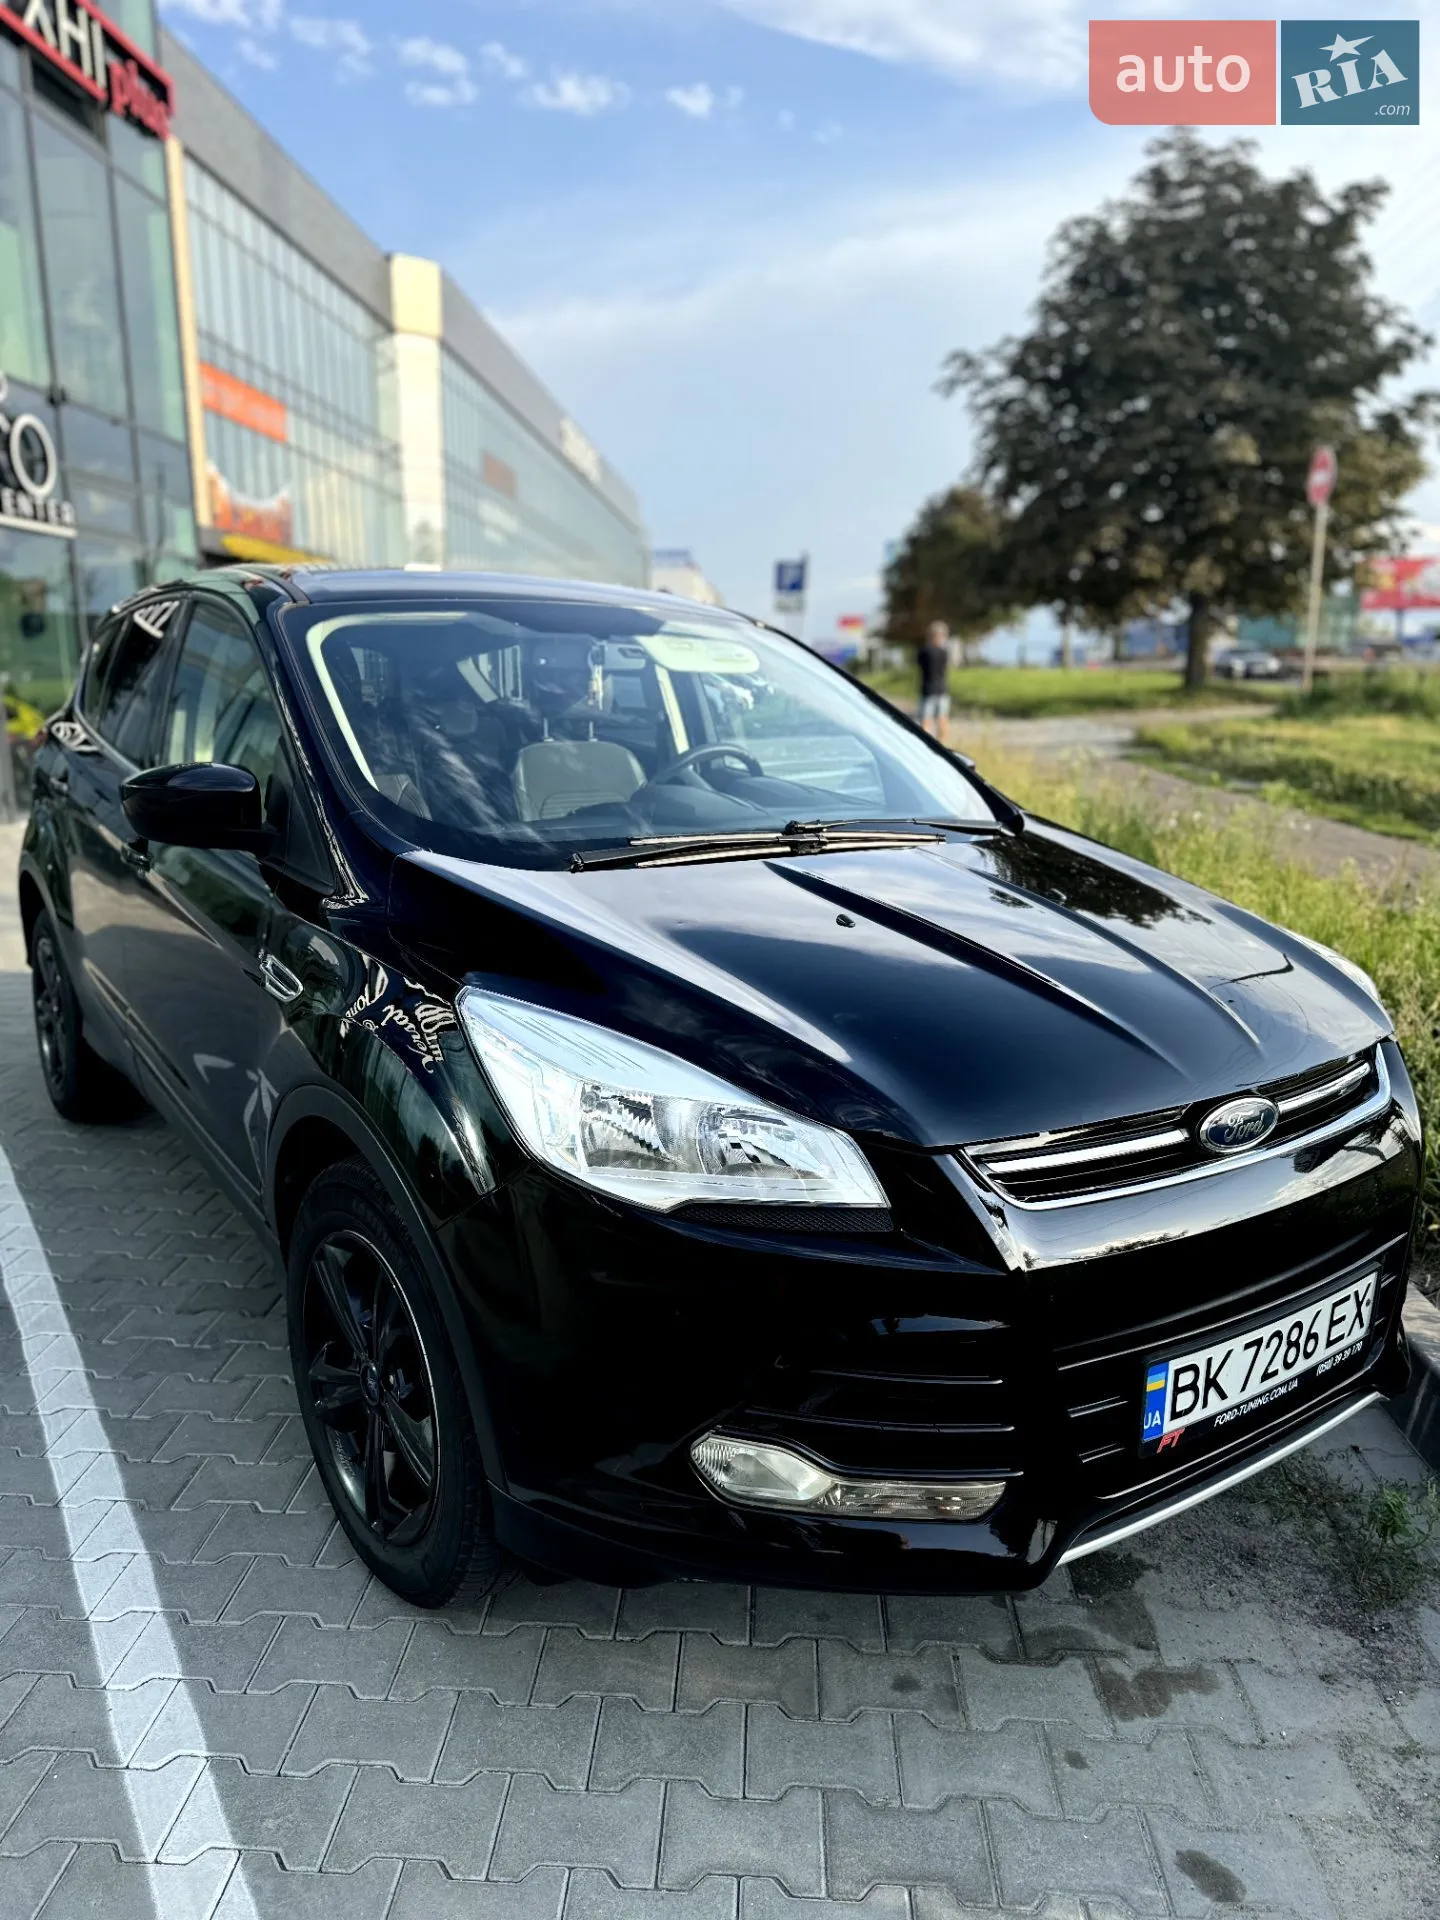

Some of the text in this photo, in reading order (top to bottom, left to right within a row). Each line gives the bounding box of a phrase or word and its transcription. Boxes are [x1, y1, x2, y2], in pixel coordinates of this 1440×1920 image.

[1223, 1109, 1265, 1143] Ford
[1169, 1282, 1372, 1423] BK 7286 EX
[1143, 1410, 1162, 1430] UA
[1213, 1377, 1299, 1428] FORD-TUNING.COM.UA
